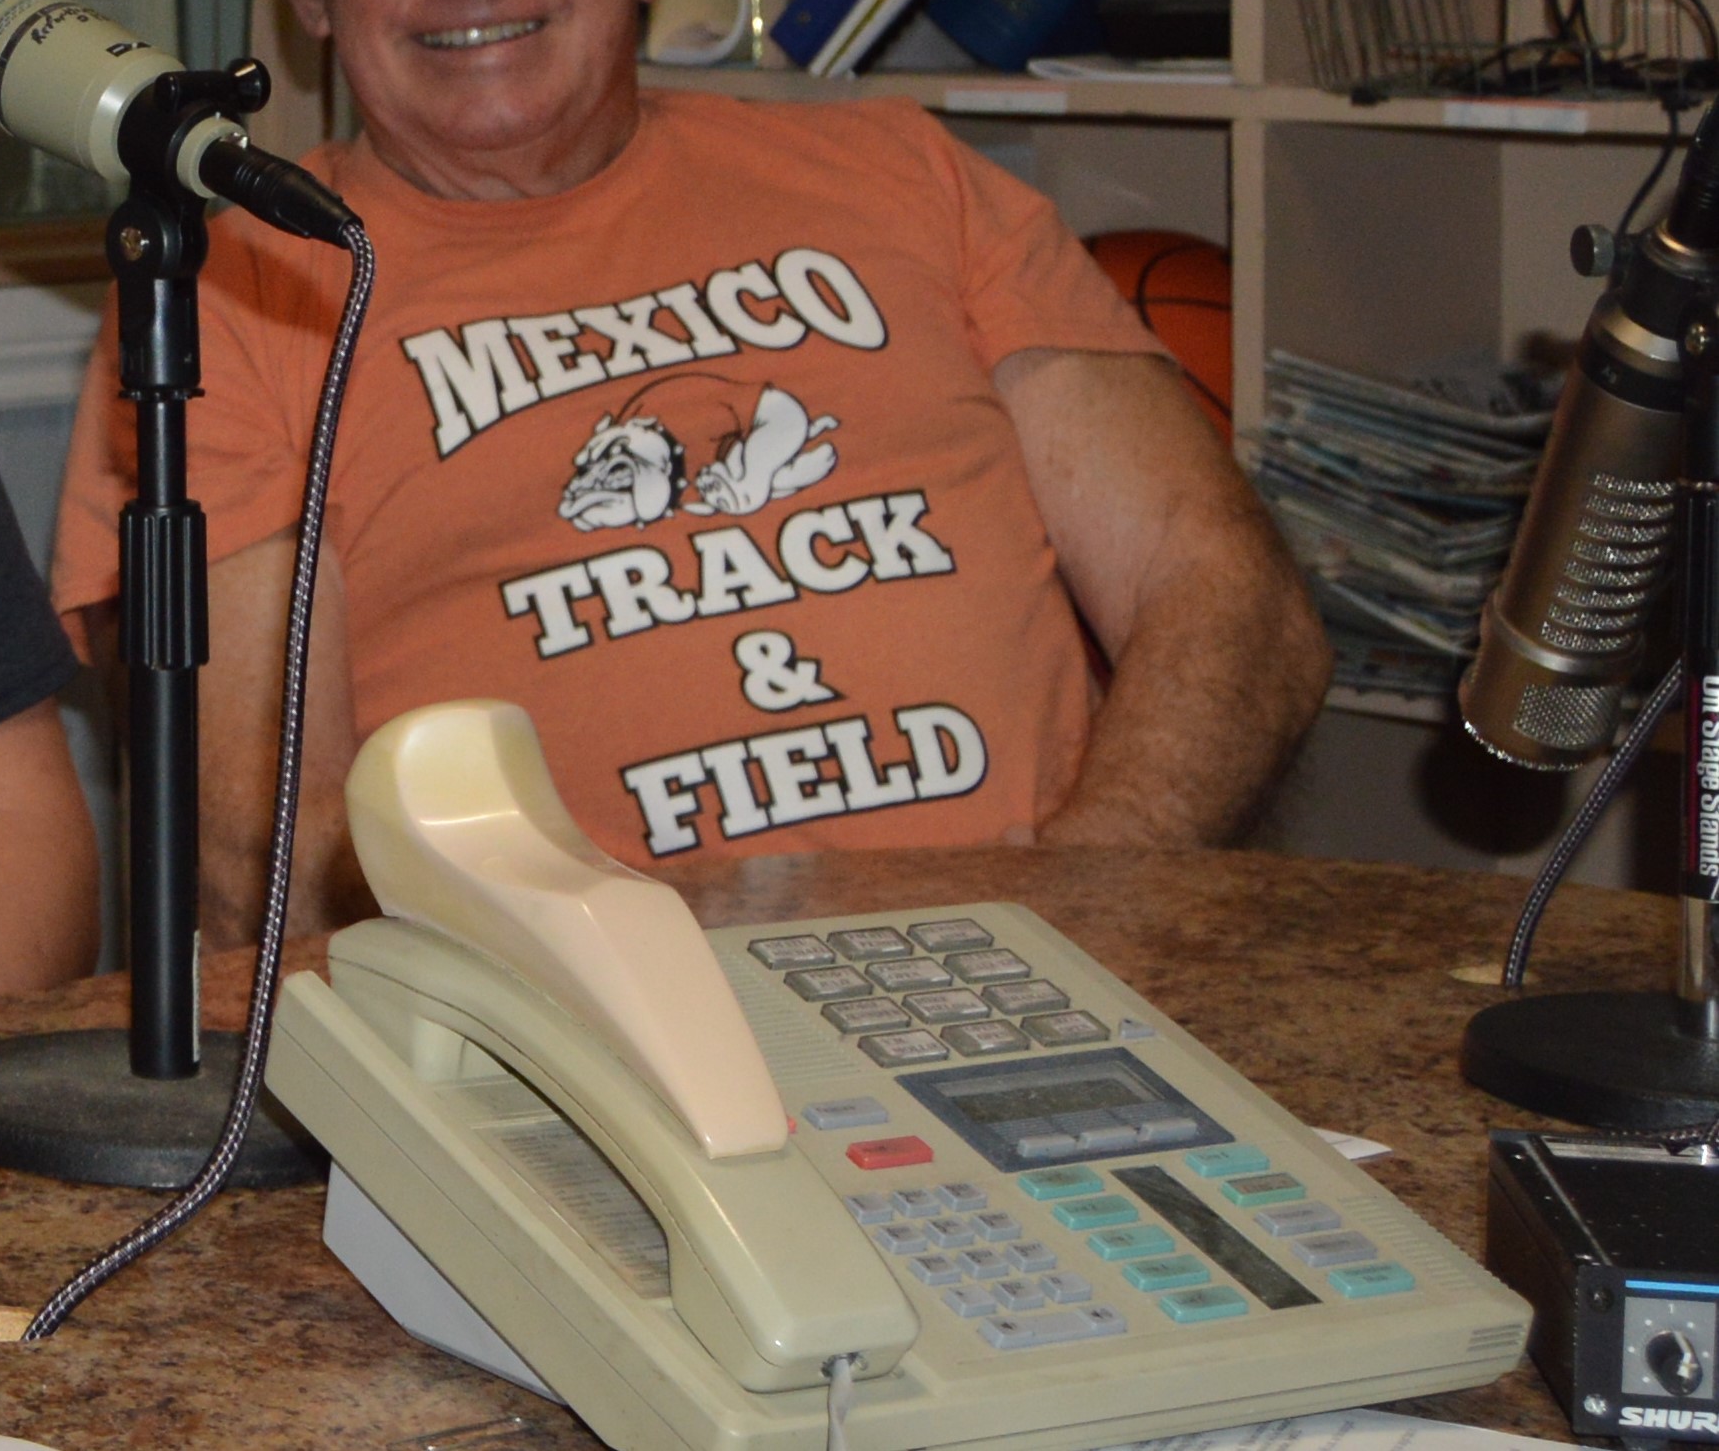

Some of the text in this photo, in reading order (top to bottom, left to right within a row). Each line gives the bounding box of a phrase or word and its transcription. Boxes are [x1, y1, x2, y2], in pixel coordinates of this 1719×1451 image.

[401, 247, 889, 461] MEXICO
[500, 488, 956, 661] TRACK
[730, 628, 845, 713] &
[618, 702, 988, 858] FIELD
[1618, 1406, 1719, 1435] SHUR
